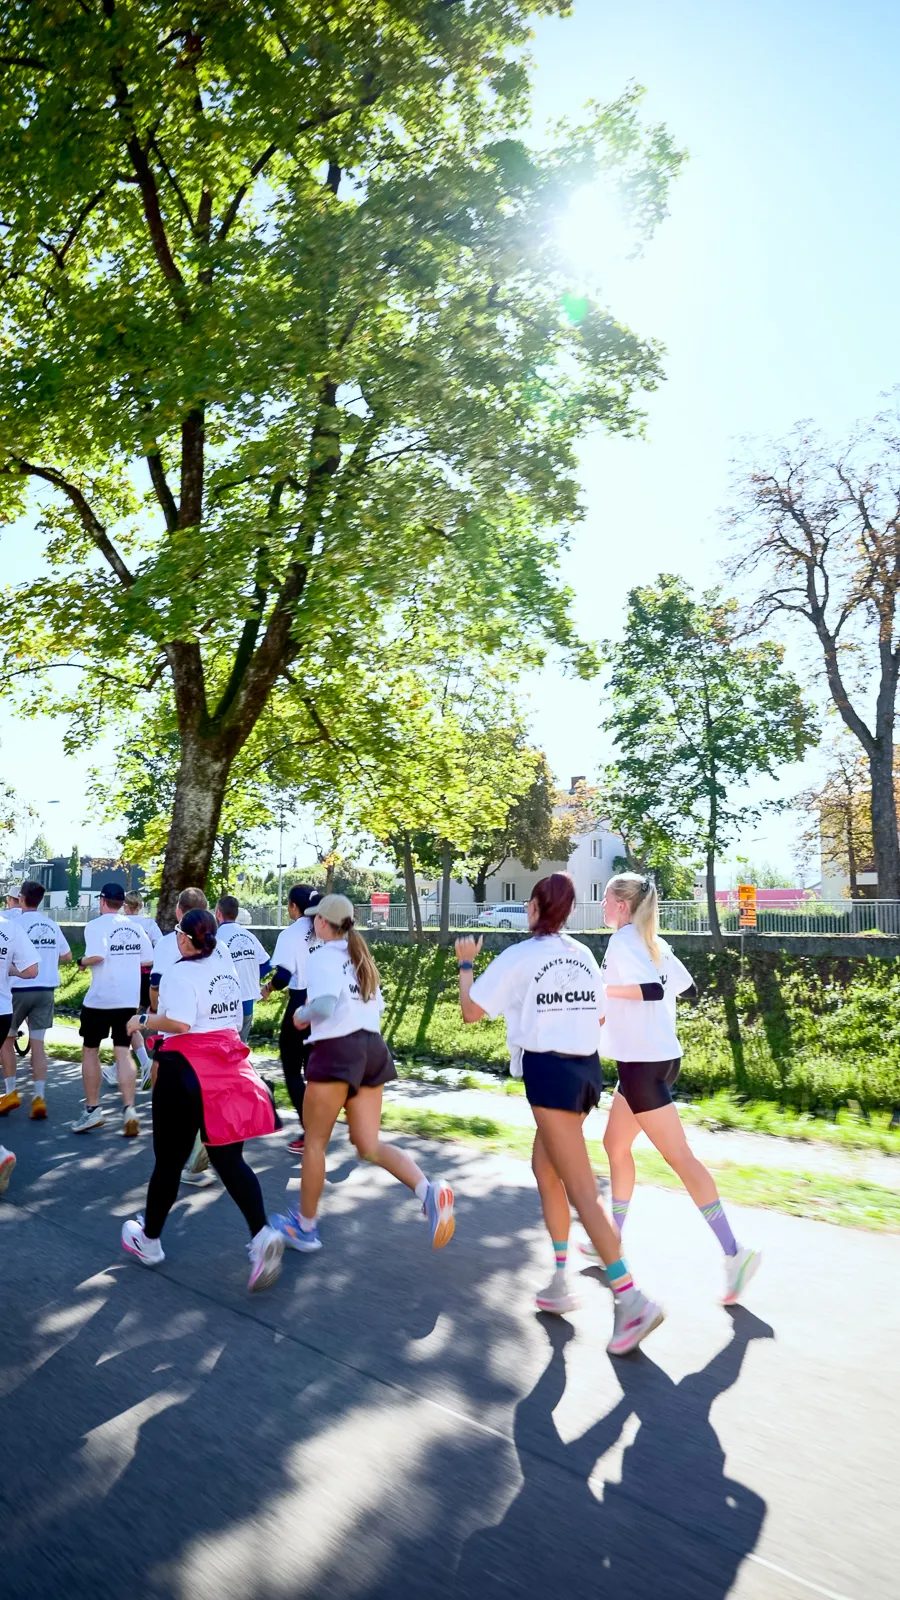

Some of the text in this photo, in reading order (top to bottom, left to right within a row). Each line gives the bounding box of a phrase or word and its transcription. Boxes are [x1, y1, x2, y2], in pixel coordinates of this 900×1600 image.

[534, 958, 563, 983] ALWAYS
[565, 957, 594, 981] MOVIN
[536, 991, 563, 1006] RUN
[210, 1001, 229, 1015] RUN
